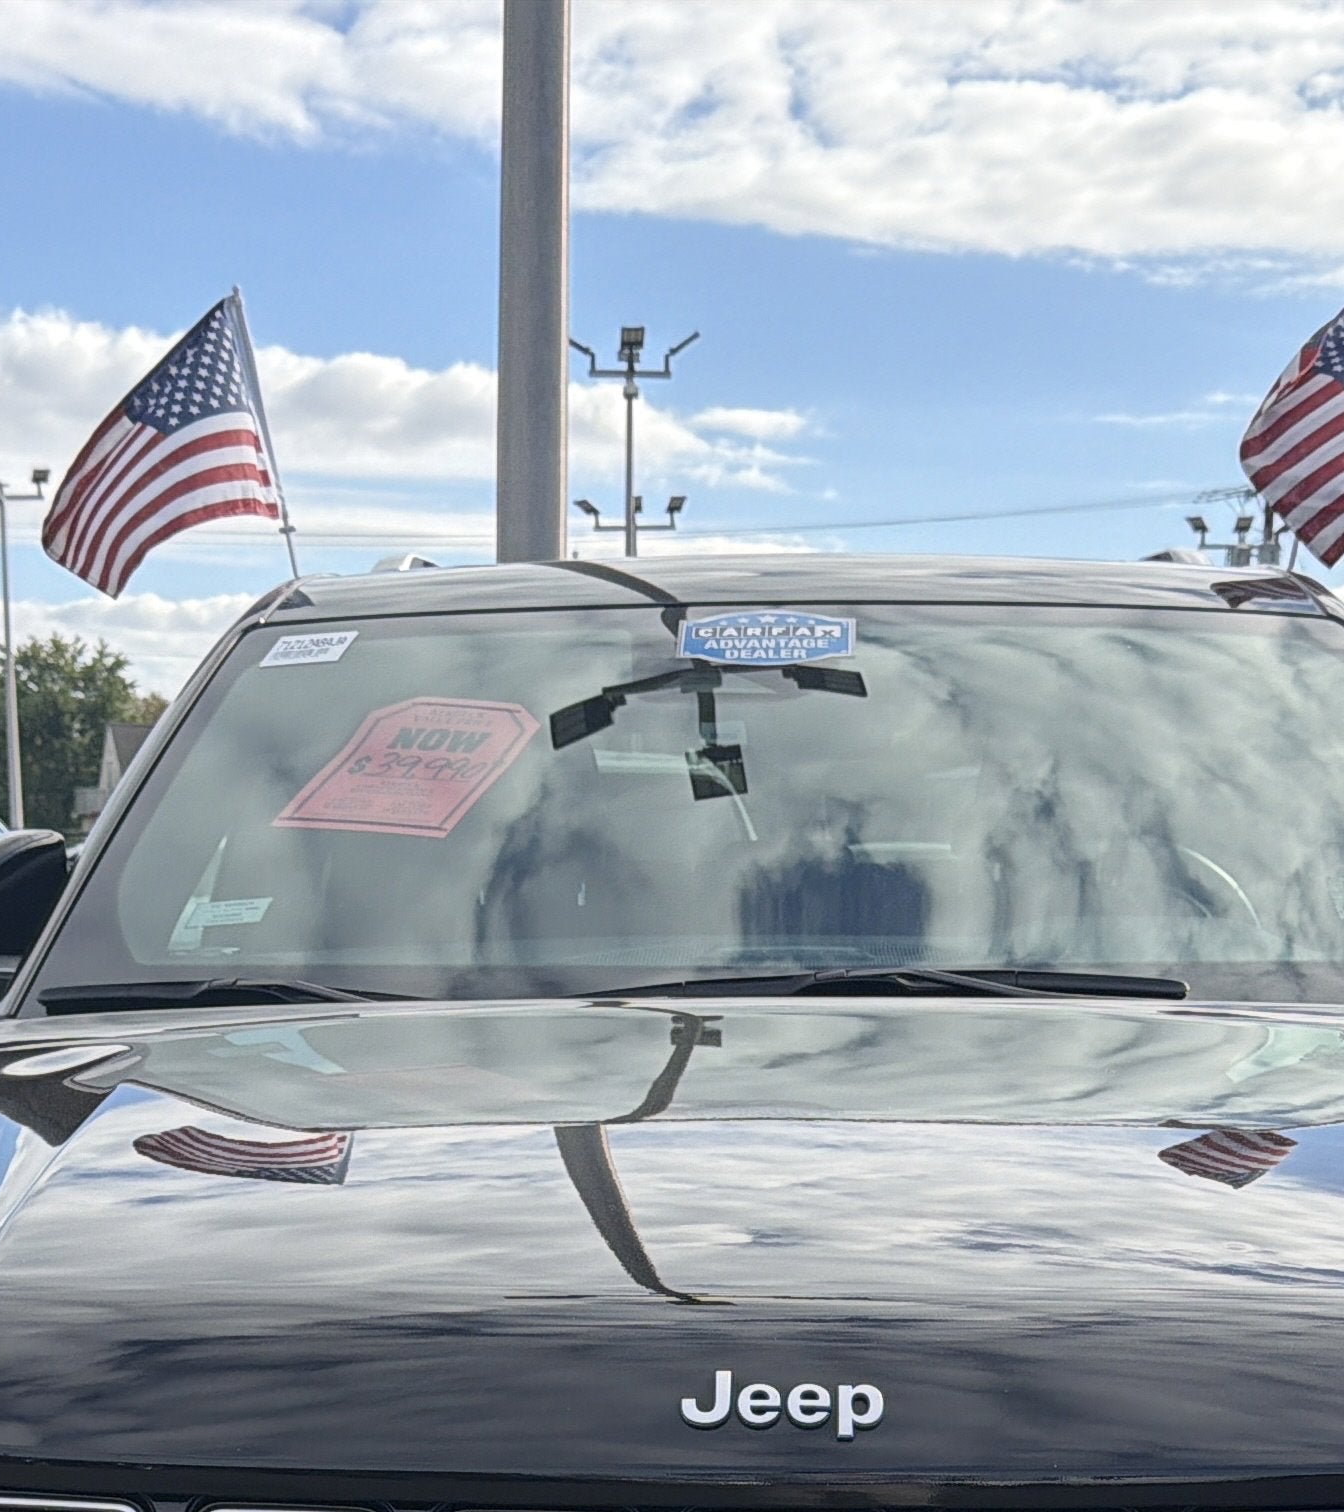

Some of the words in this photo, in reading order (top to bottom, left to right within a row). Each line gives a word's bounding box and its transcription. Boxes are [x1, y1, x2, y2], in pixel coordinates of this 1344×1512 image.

[697, 626, 840, 638] CARFAX
[704, 638, 830, 650] ADVANTAGE
[725, 649, 808, 660] DEALER
[387, 727, 492, 752] NOW
[680, 1370, 885, 1441] Jeep
